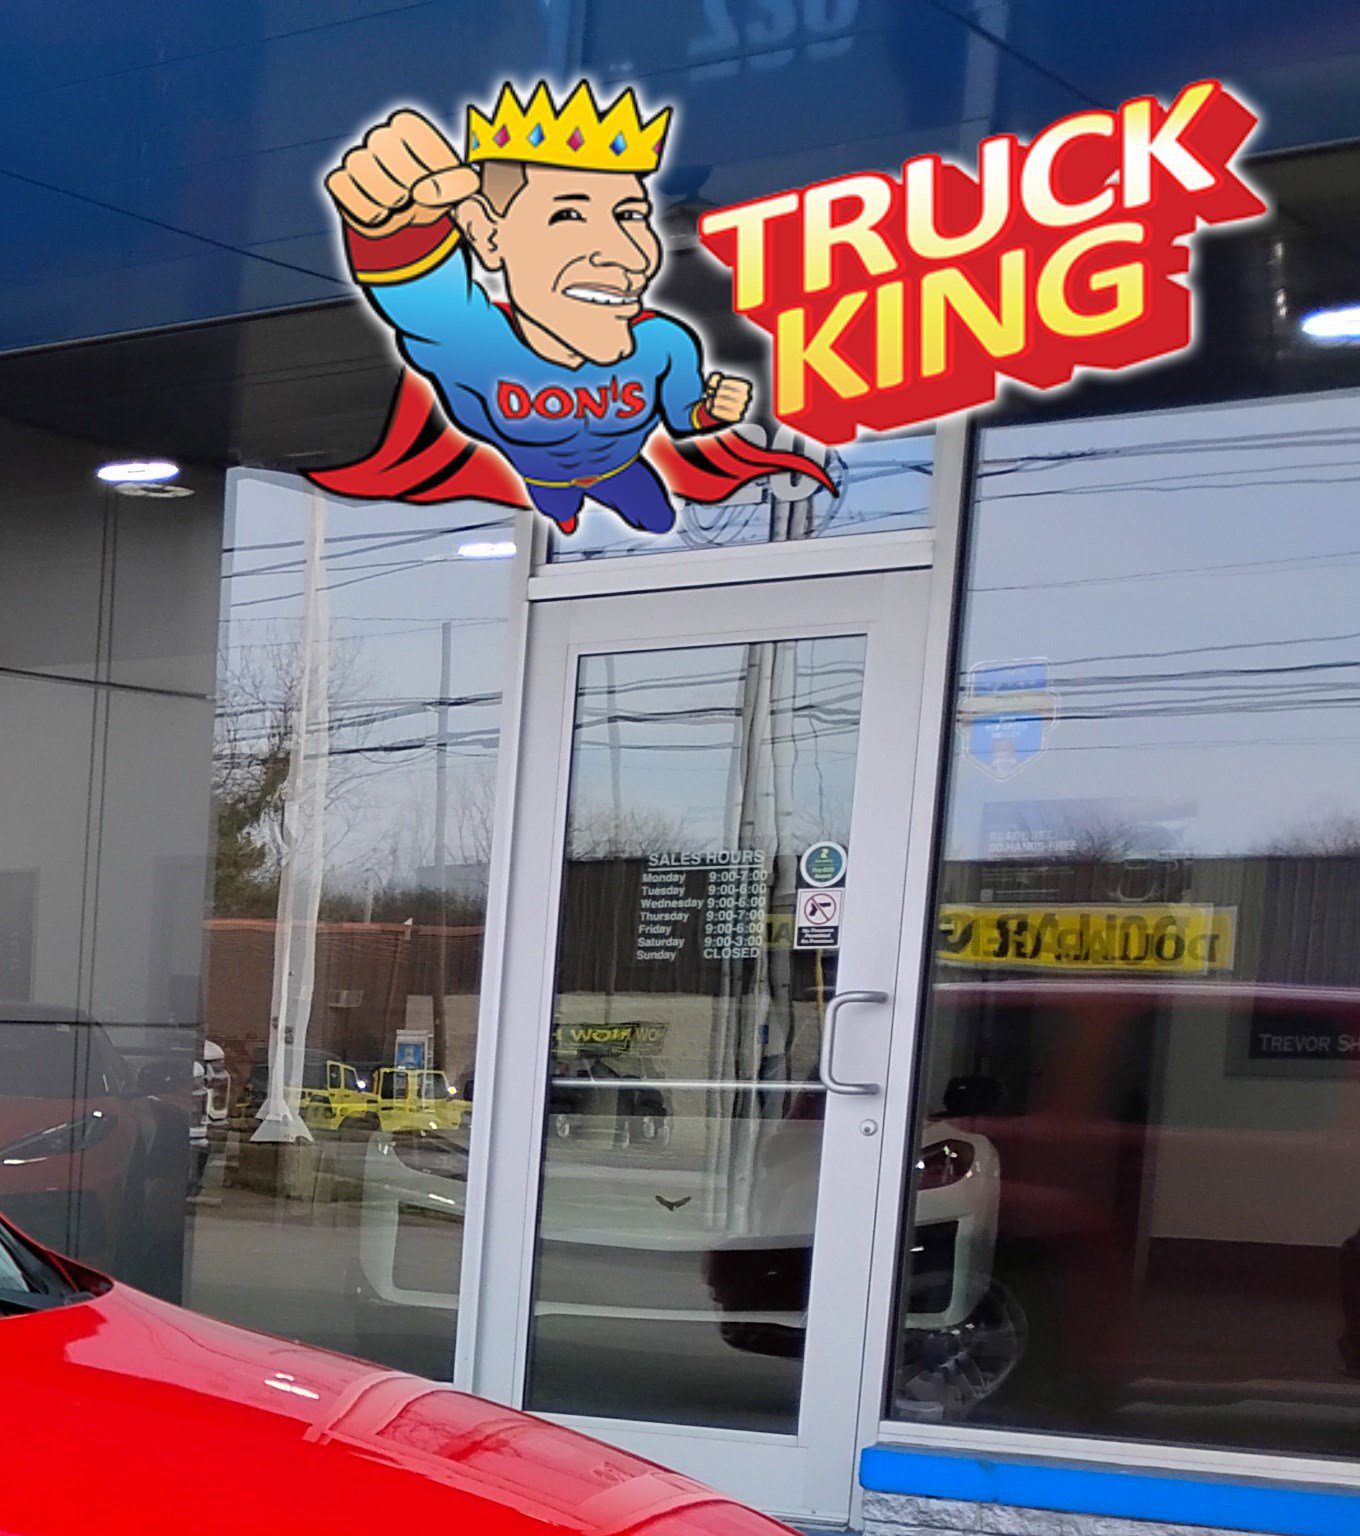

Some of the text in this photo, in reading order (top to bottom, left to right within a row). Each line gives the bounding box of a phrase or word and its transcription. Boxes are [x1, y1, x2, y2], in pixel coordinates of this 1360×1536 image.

[648, 850, 765, 866] SALES HOURS
[642, 873, 686, 884] Monday
[641, 886, 686, 897] Tuesday
[640, 898, 704, 909] Wednesday
[640, 911, 689, 922] Thursday
[639, 924, 672, 935] Friday
[638, 938, 685, 948] Saturday
[637, 948, 760, 961] Sunday CLOSED
[1259, 1033, 1330, 1052] TREVOR
